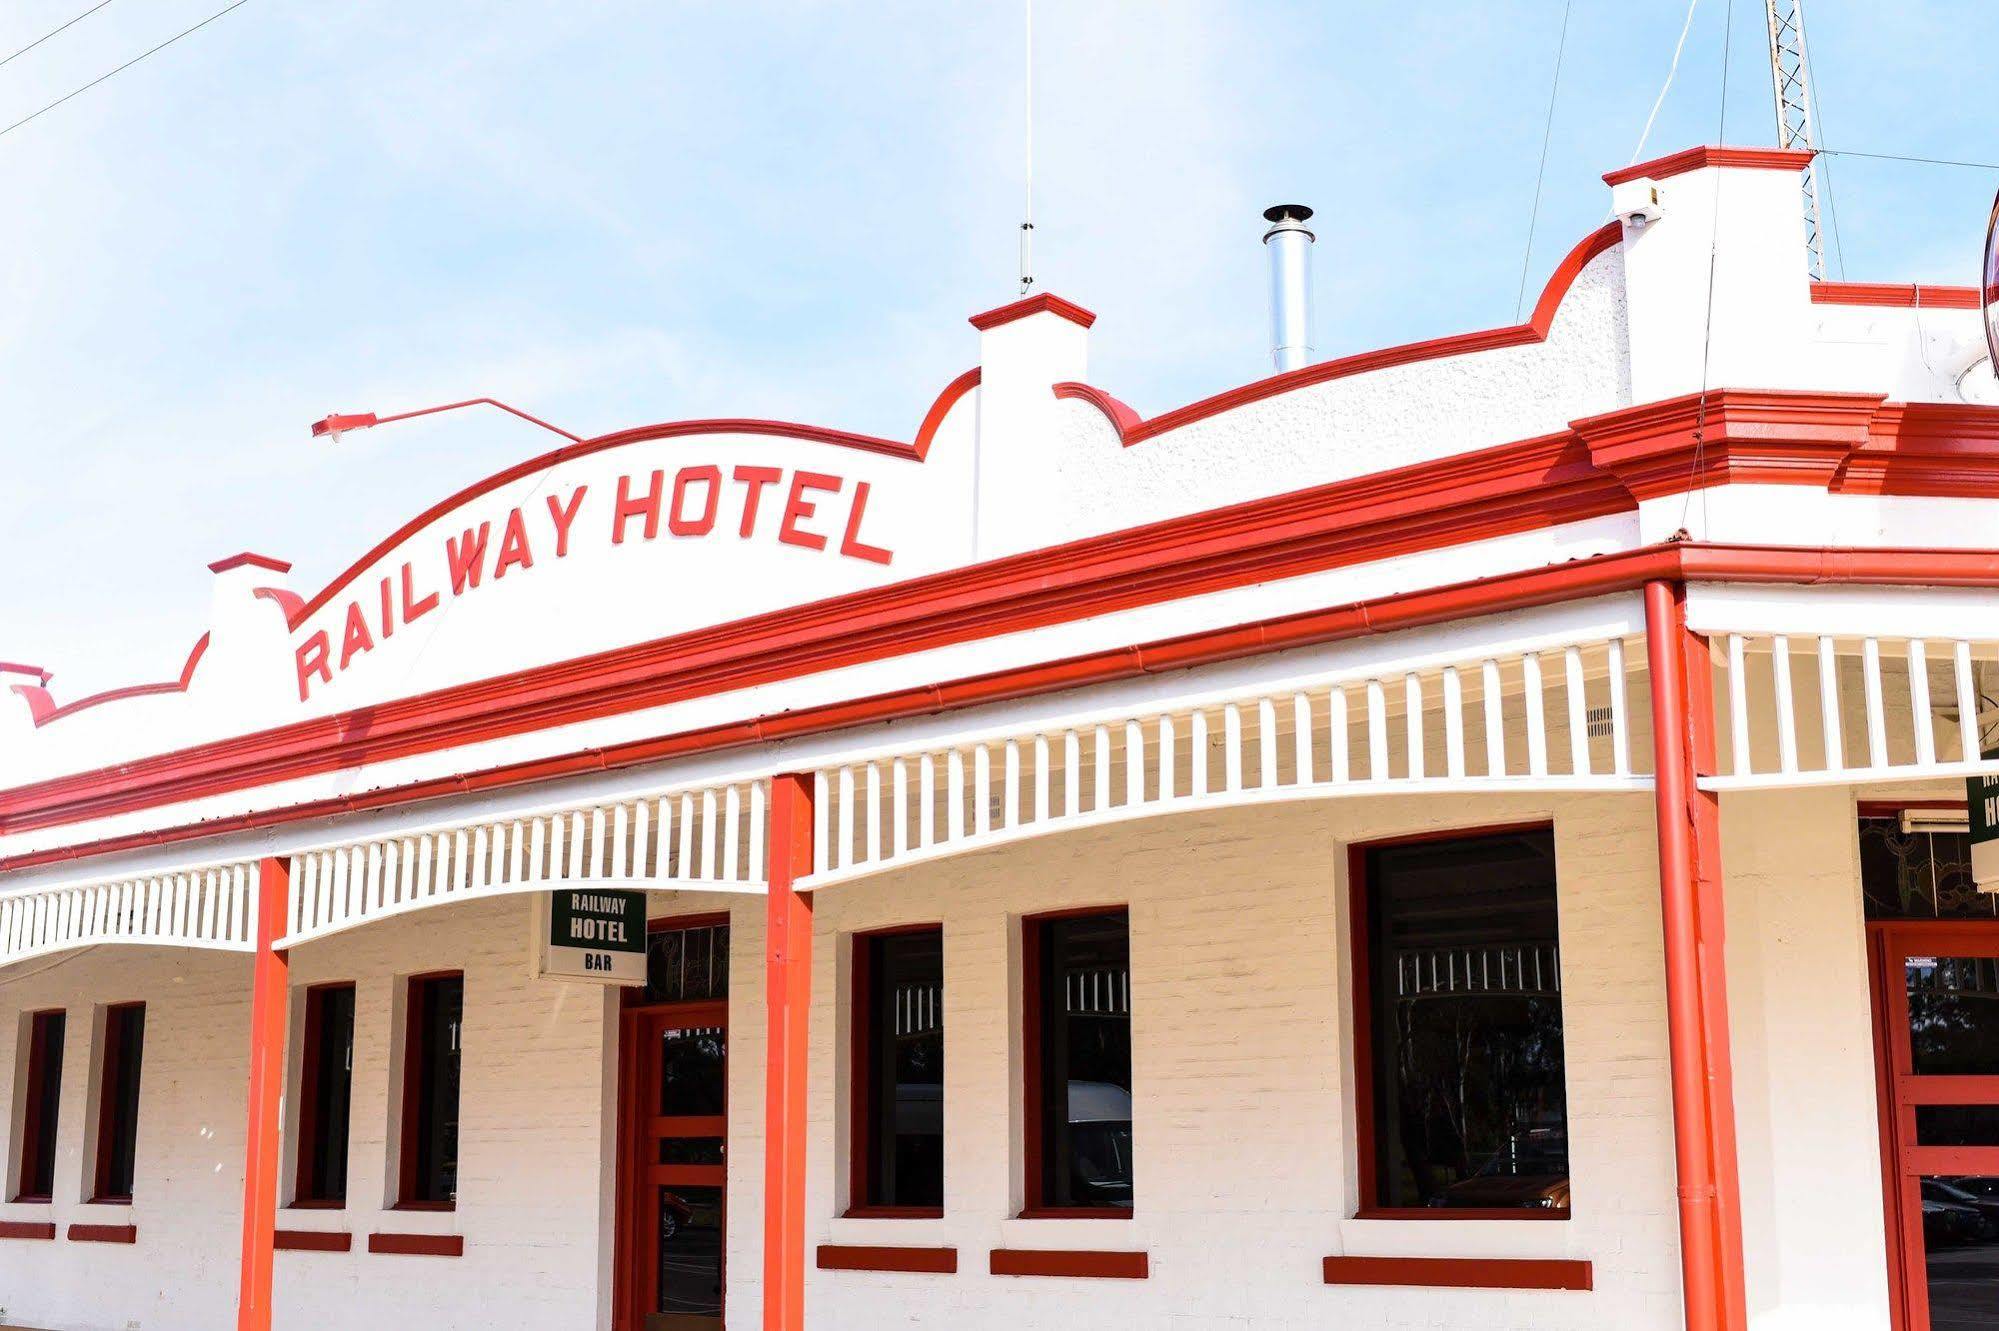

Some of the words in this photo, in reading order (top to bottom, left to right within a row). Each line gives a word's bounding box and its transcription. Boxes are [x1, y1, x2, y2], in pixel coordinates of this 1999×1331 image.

[295, 485, 588, 702] RAILWAY
[612, 464, 893, 565] HOTEL
[571, 893, 627, 914] RAILWAY
[570, 917, 627, 942] HOTEL
[585, 953, 612, 971] BAR
